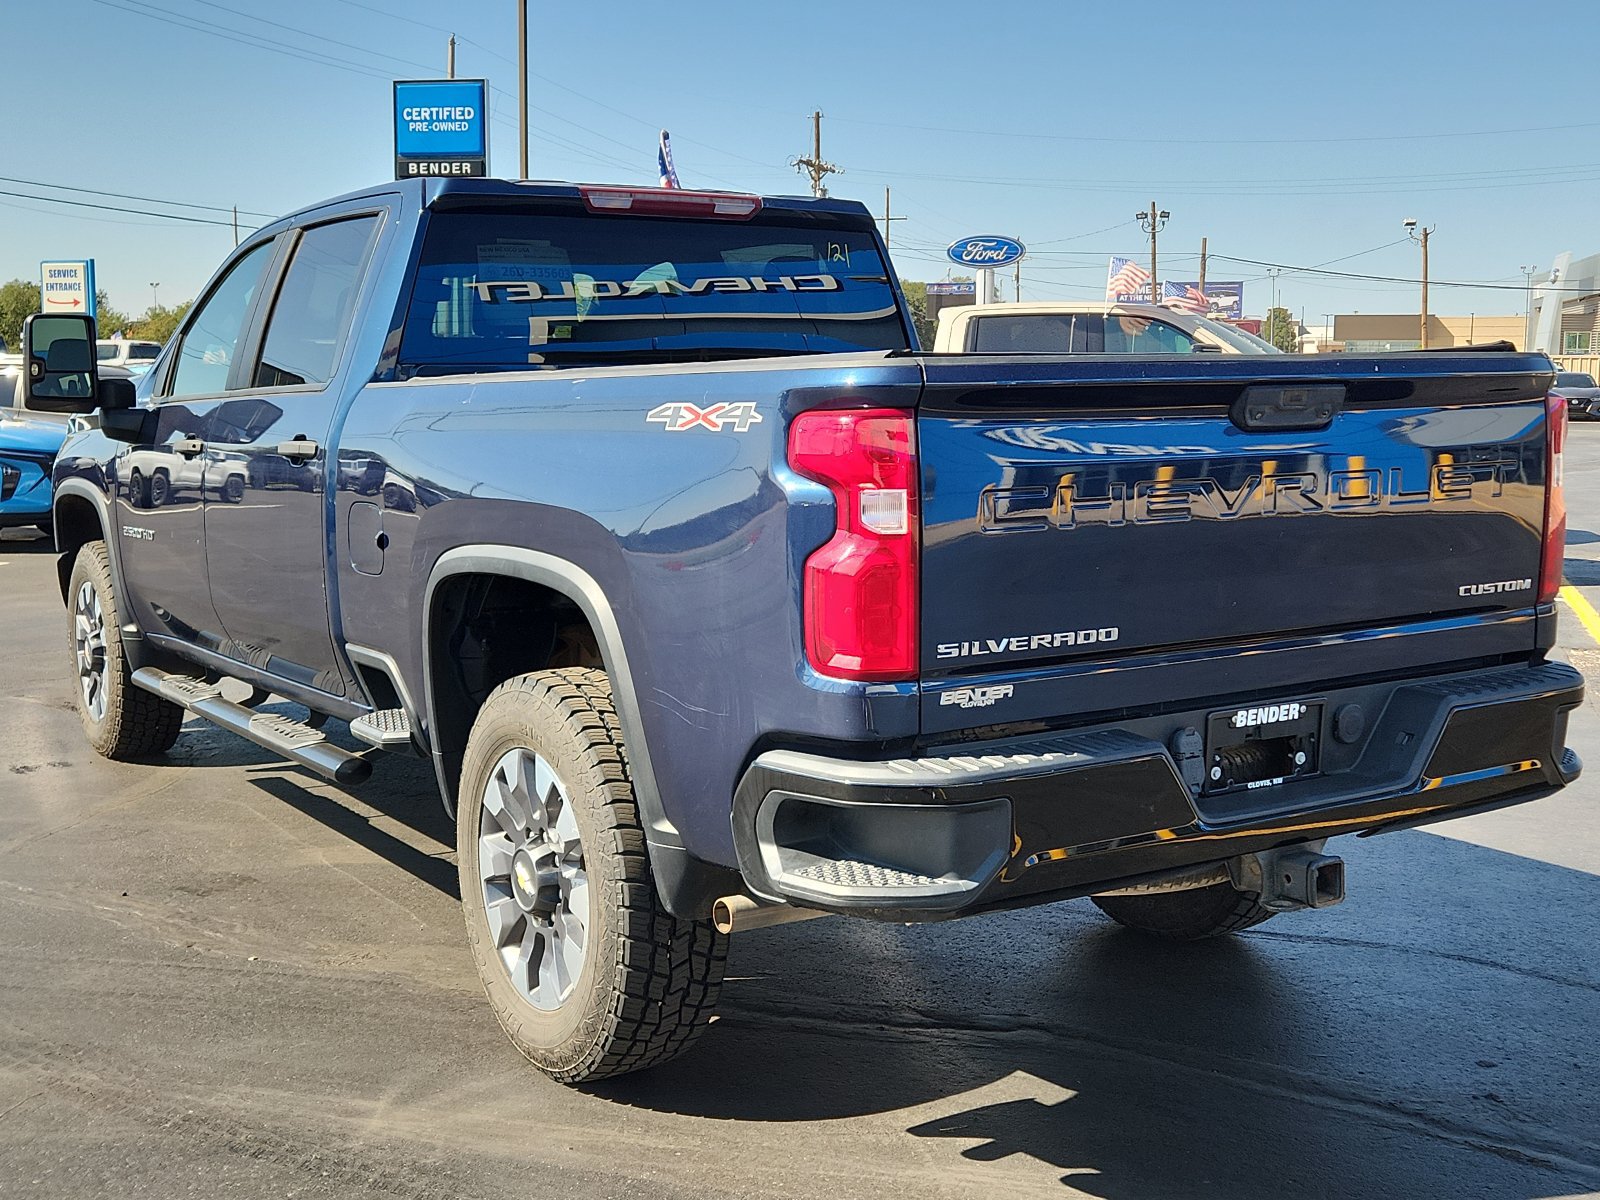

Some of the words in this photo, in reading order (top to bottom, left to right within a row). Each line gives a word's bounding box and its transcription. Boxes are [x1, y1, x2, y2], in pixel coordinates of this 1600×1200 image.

[403, 107, 475, 121] CERTIFIED
[409, 122, 469, 132] PRE-OWNED
[408, 162, 471, 174] BENDER
[827, 241, 850, 268] 121
[962, 240, 1009, 261] Ford
[48, 269, 78, 278] SERVICE
[45, 282, 82, 292] ENTRANCE
[980, 459, 1517, 534] CHEVROLET
[1459, 578, 1532, 597] CUSTOM
[936, 627, 1119, 659] SILVERADO
[939, 684, 1014, 706] BENDER
[1235, 703, 1300, 728] BENDER
